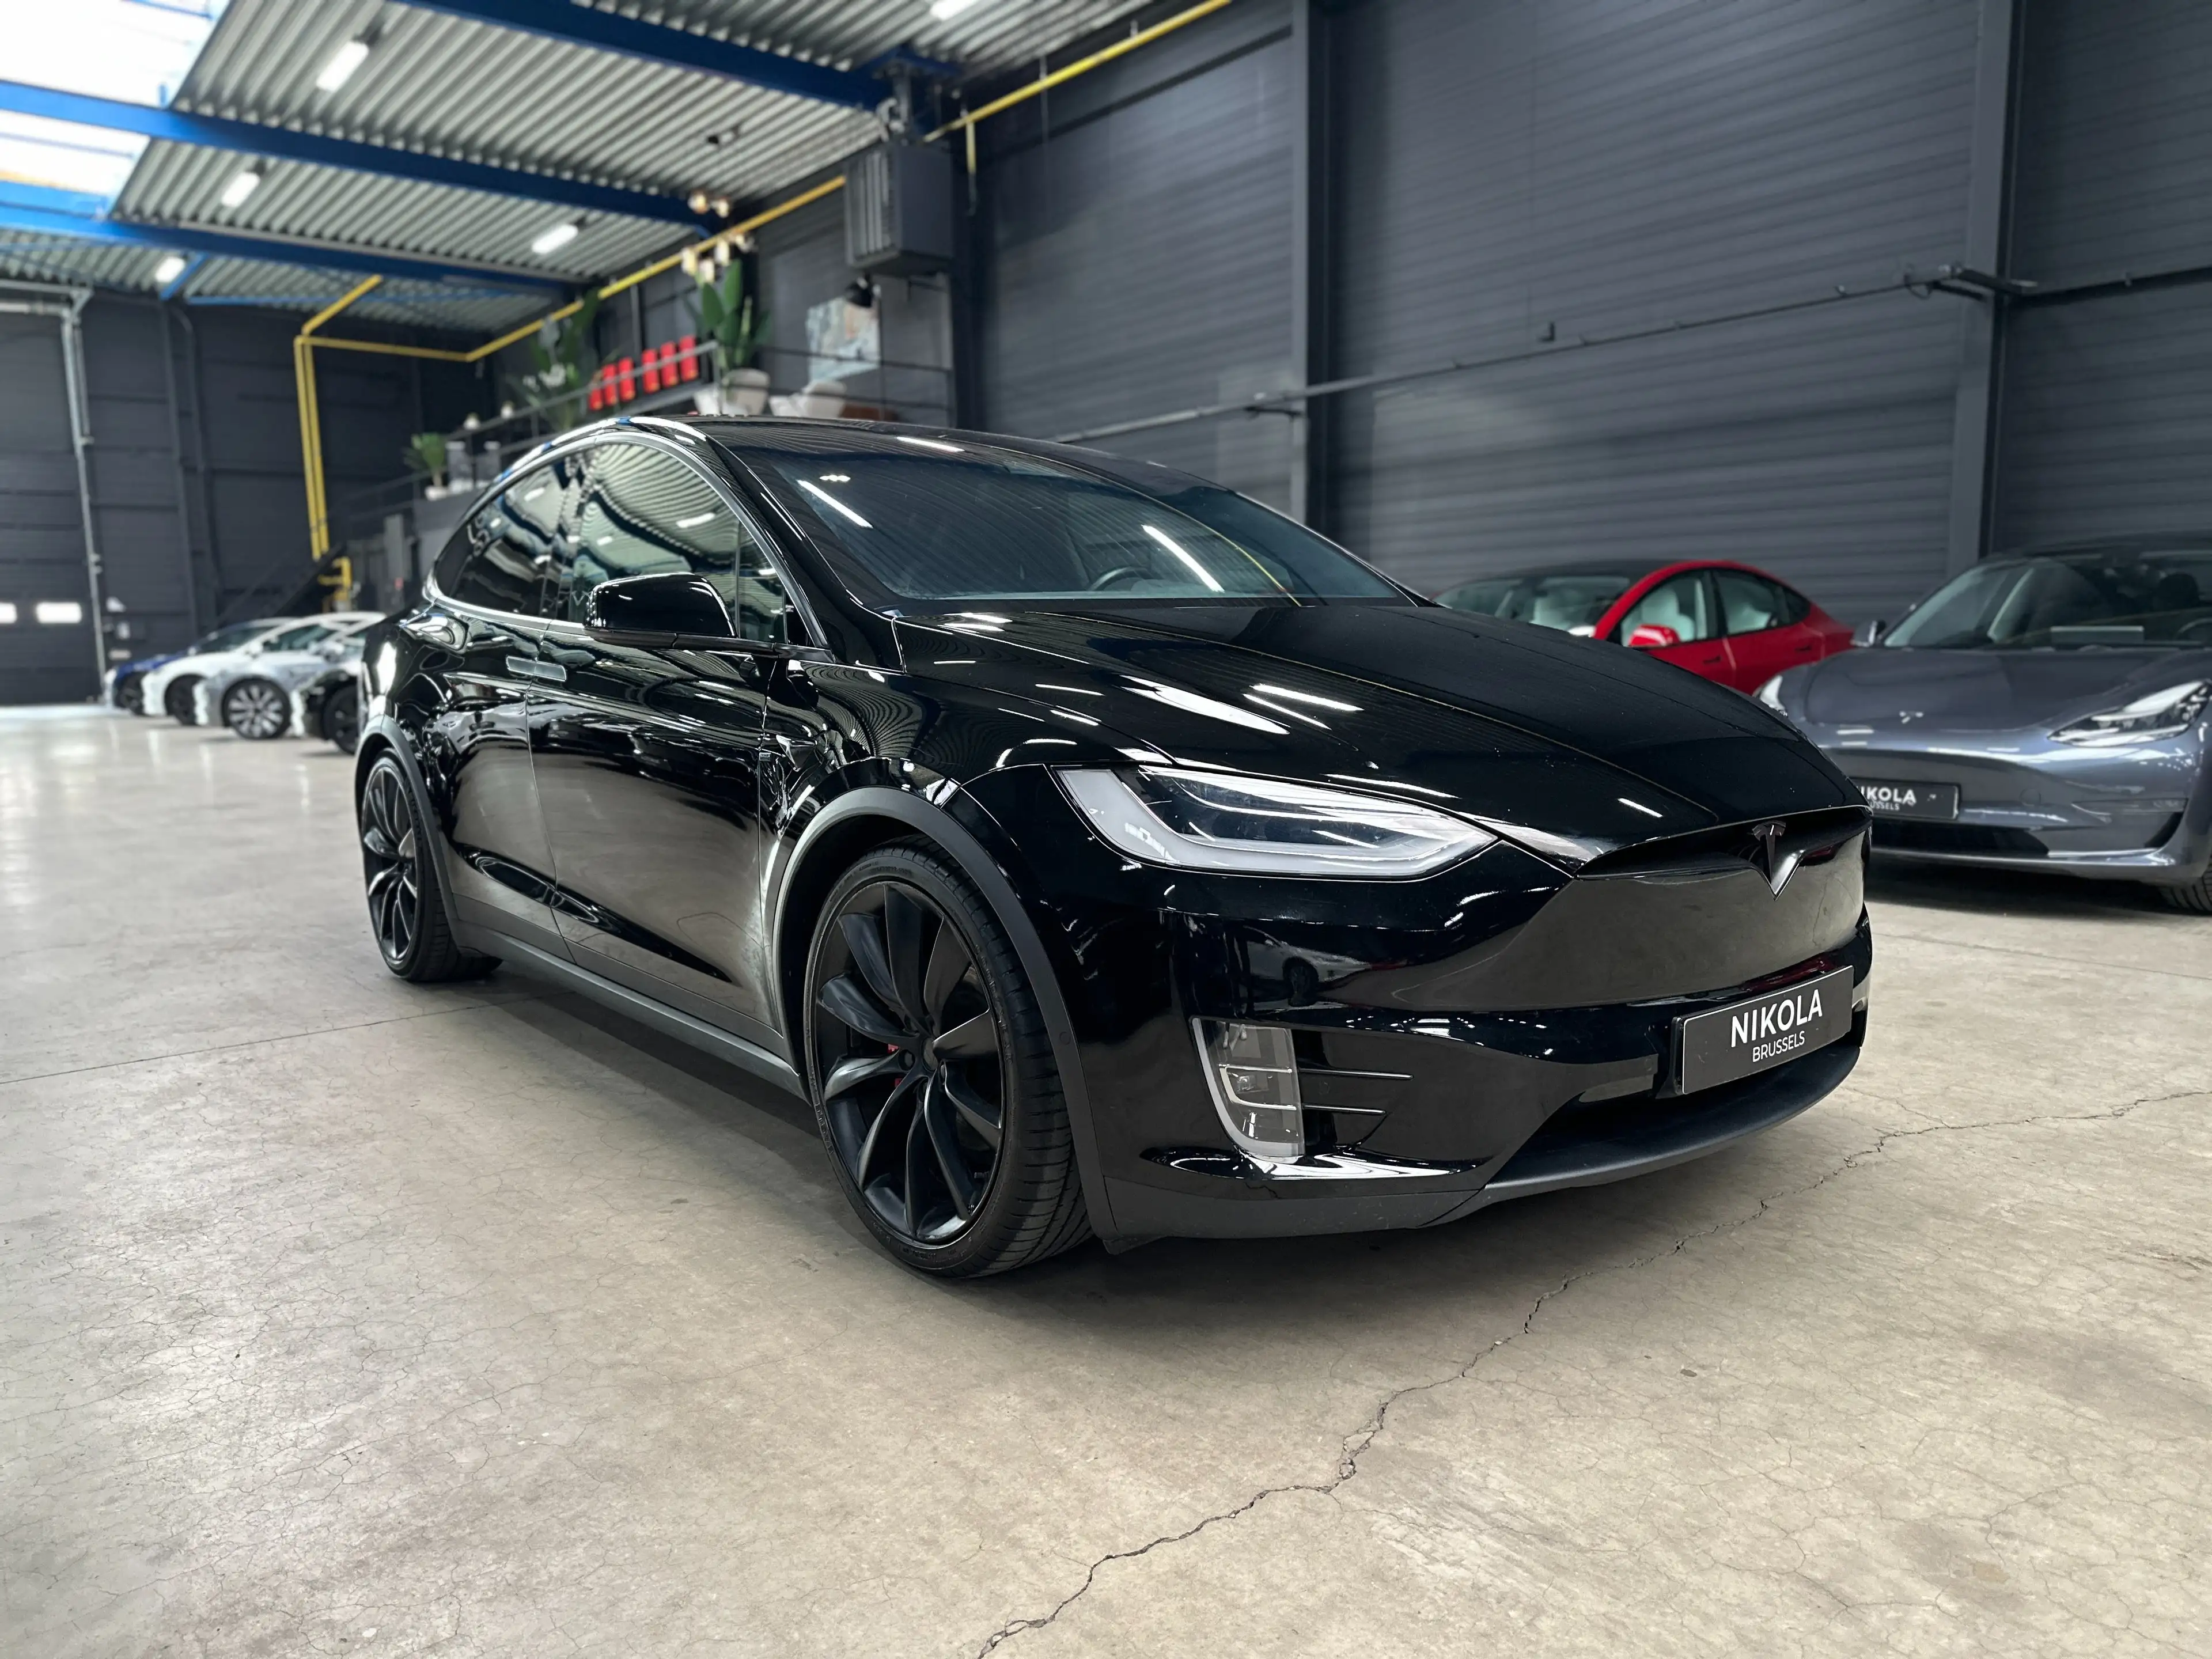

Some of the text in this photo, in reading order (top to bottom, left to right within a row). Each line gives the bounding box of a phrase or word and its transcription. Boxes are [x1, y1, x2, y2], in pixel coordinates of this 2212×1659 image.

[1856, 786, 1916, 804] IKOLA
[1870, 801, 1900, 810] USSELS
[1730, 988, 1823, 1048] NIKOLA
[1752, 1030, 1805, 1063] BRUSSELS
